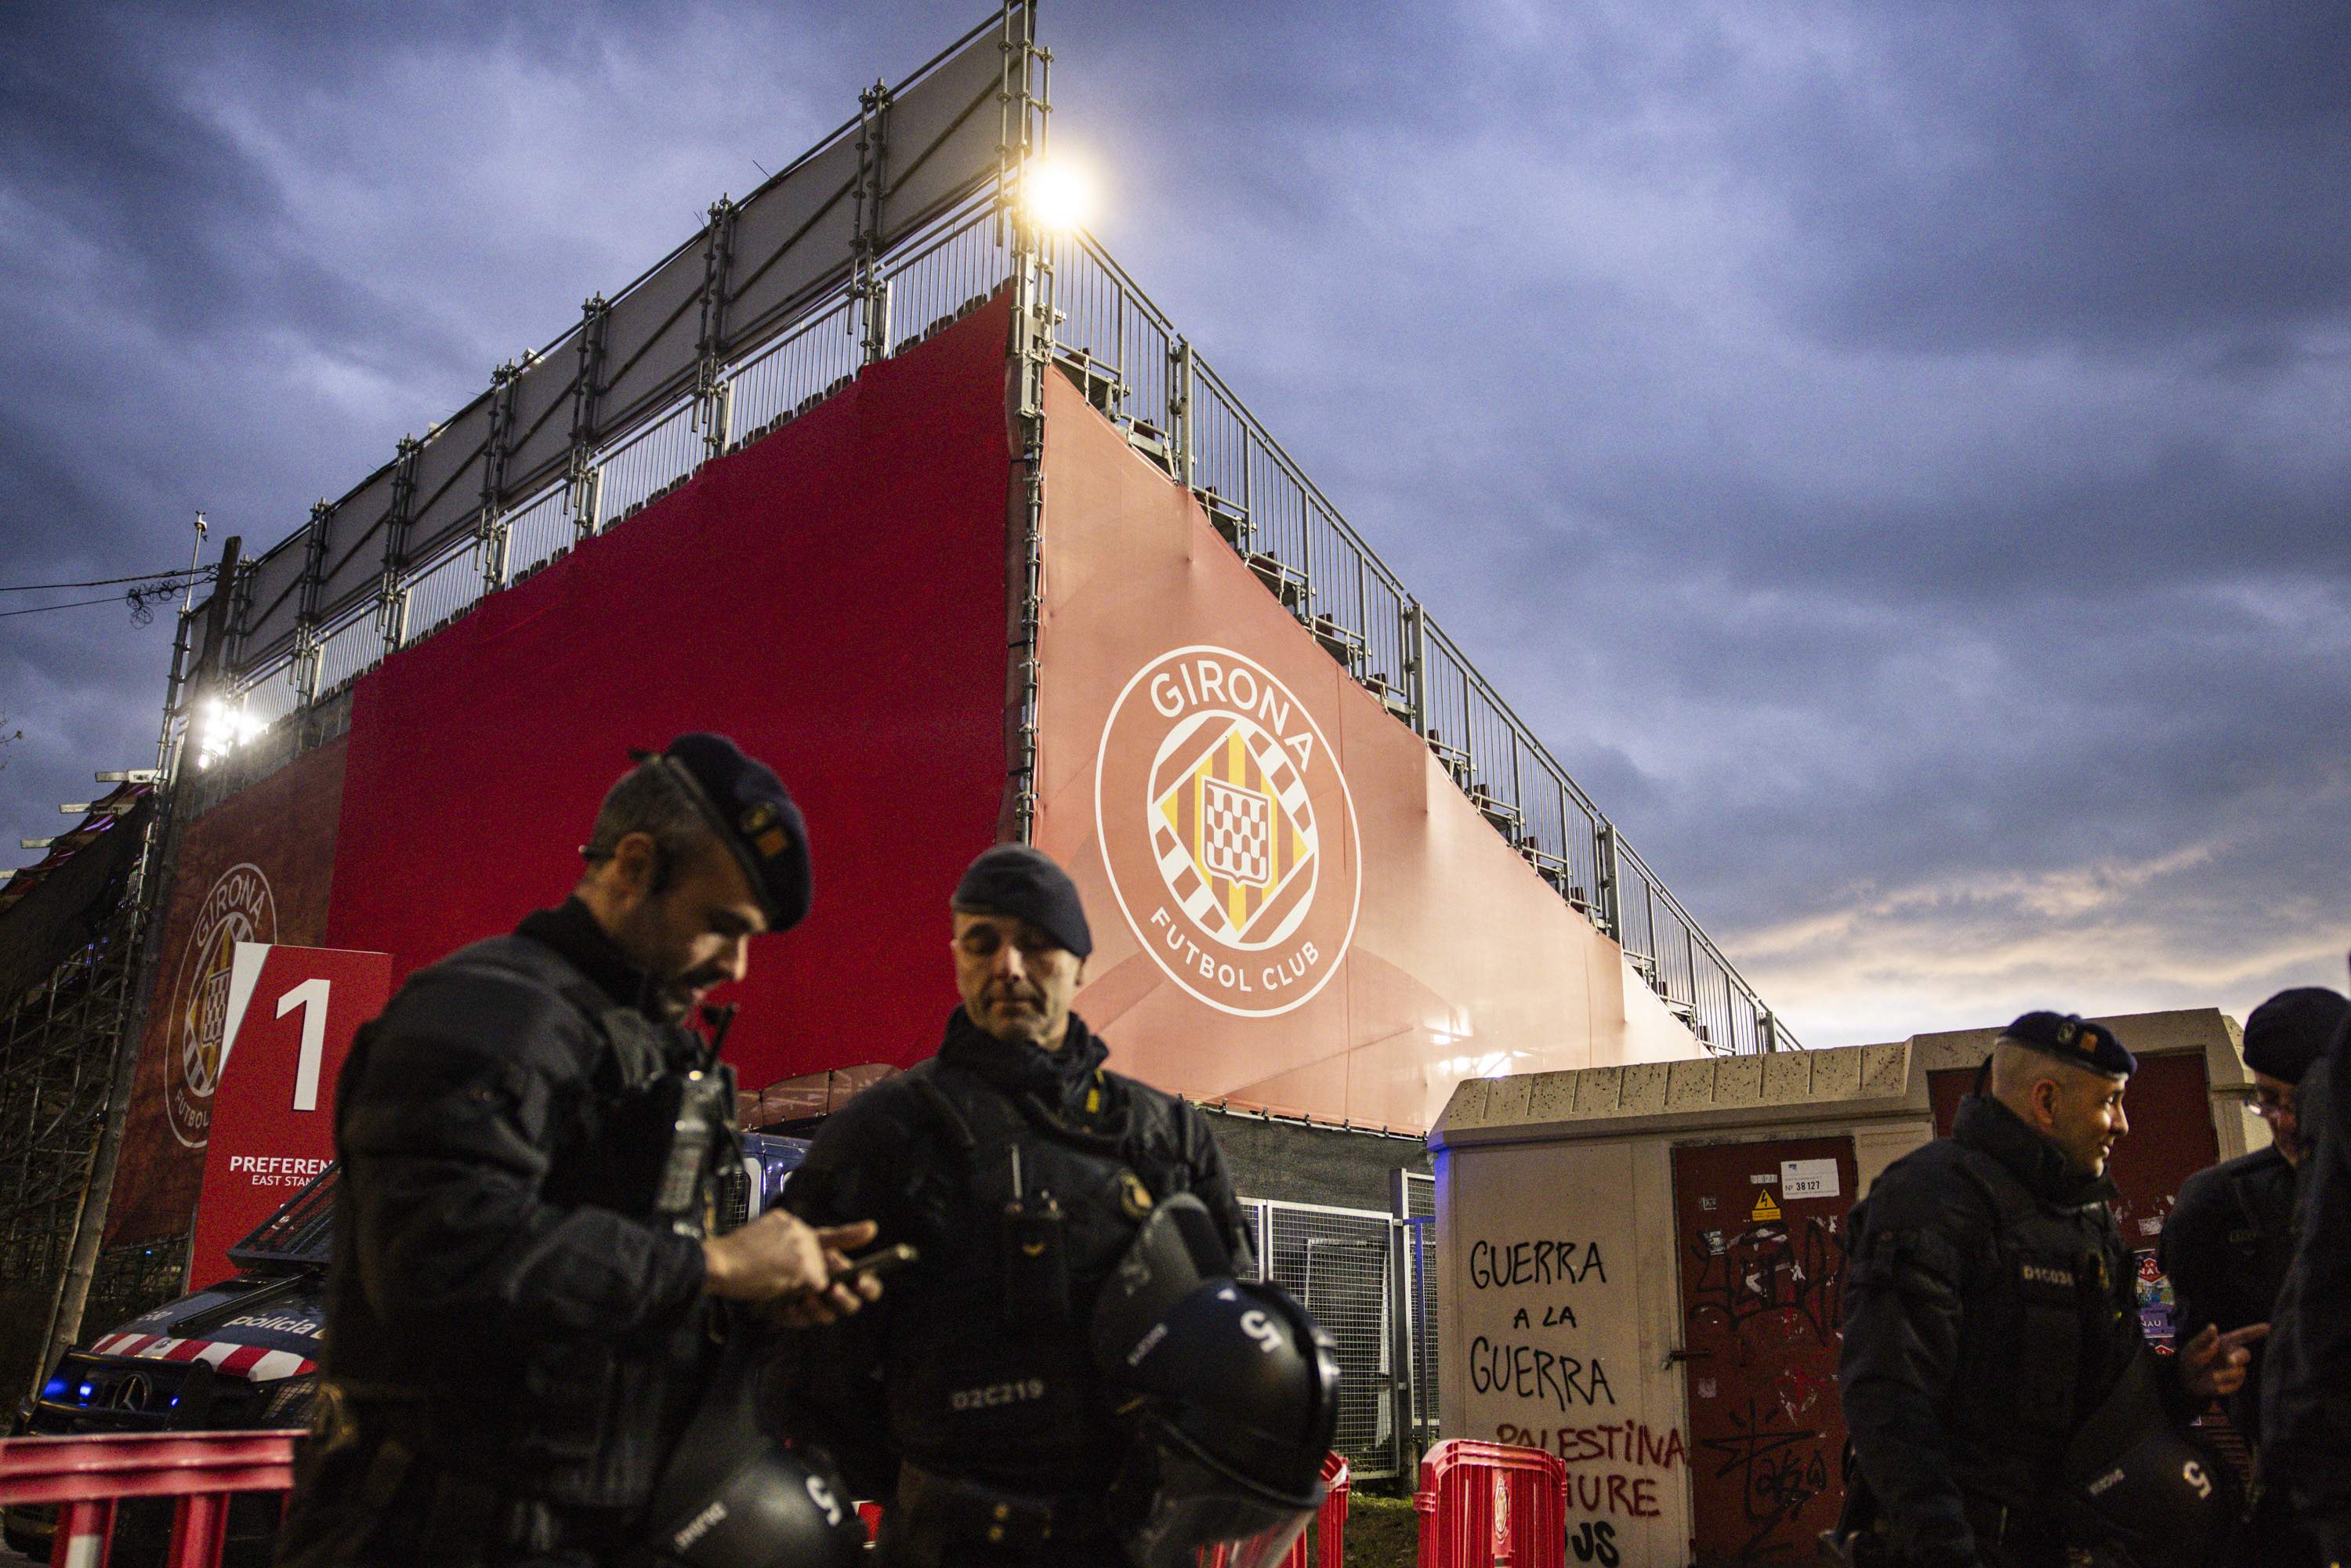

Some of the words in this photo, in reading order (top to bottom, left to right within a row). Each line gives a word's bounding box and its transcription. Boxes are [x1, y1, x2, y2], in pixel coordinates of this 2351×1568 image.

[1150, 660, 1313, 773] GIRONA
[196, 874, 265, 947] GIRONA
[1150, 907, 1252, 992] FUTBOL
[1262, 941, 1319, 990] CLUB
[276, 979, 331, 1111] 1
[252, 1175, 281, 1186] EAST
[1470, 1240, 1607, 1290] GUERRA
[1513, 1308, 1530, 1330] A
[1542, 1306, 1578, 1329] LA
[1470, 1336, 1615, 1412] GUERRA
